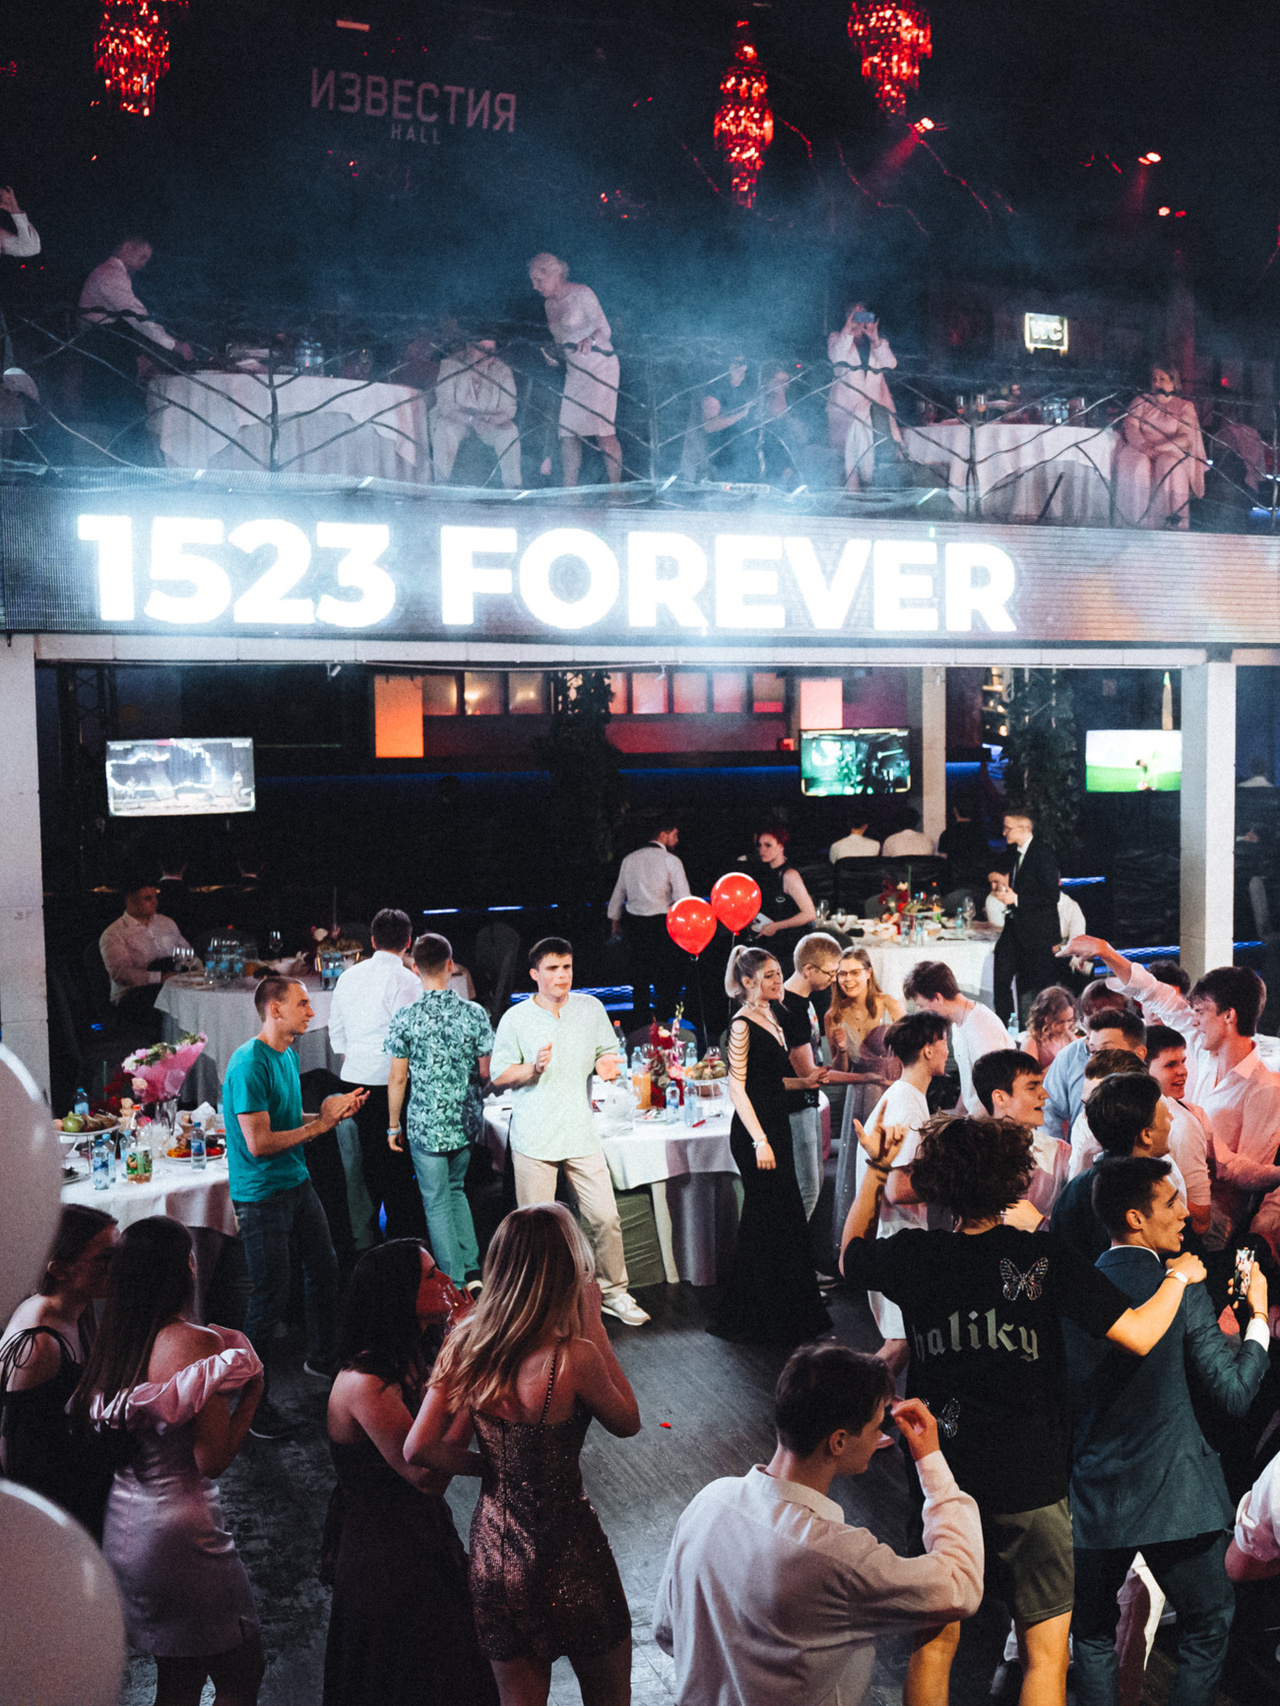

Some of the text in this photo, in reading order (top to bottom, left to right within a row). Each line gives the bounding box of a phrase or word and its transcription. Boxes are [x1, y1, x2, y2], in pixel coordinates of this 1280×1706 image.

[311, 67, 517, 134] ИЗВЕСТИЯ
[390, 123, 442, 146] HALL
[1030, 320, 1063, 341] WC
[77, 514, 1018, 633] 1523 FOREVER
